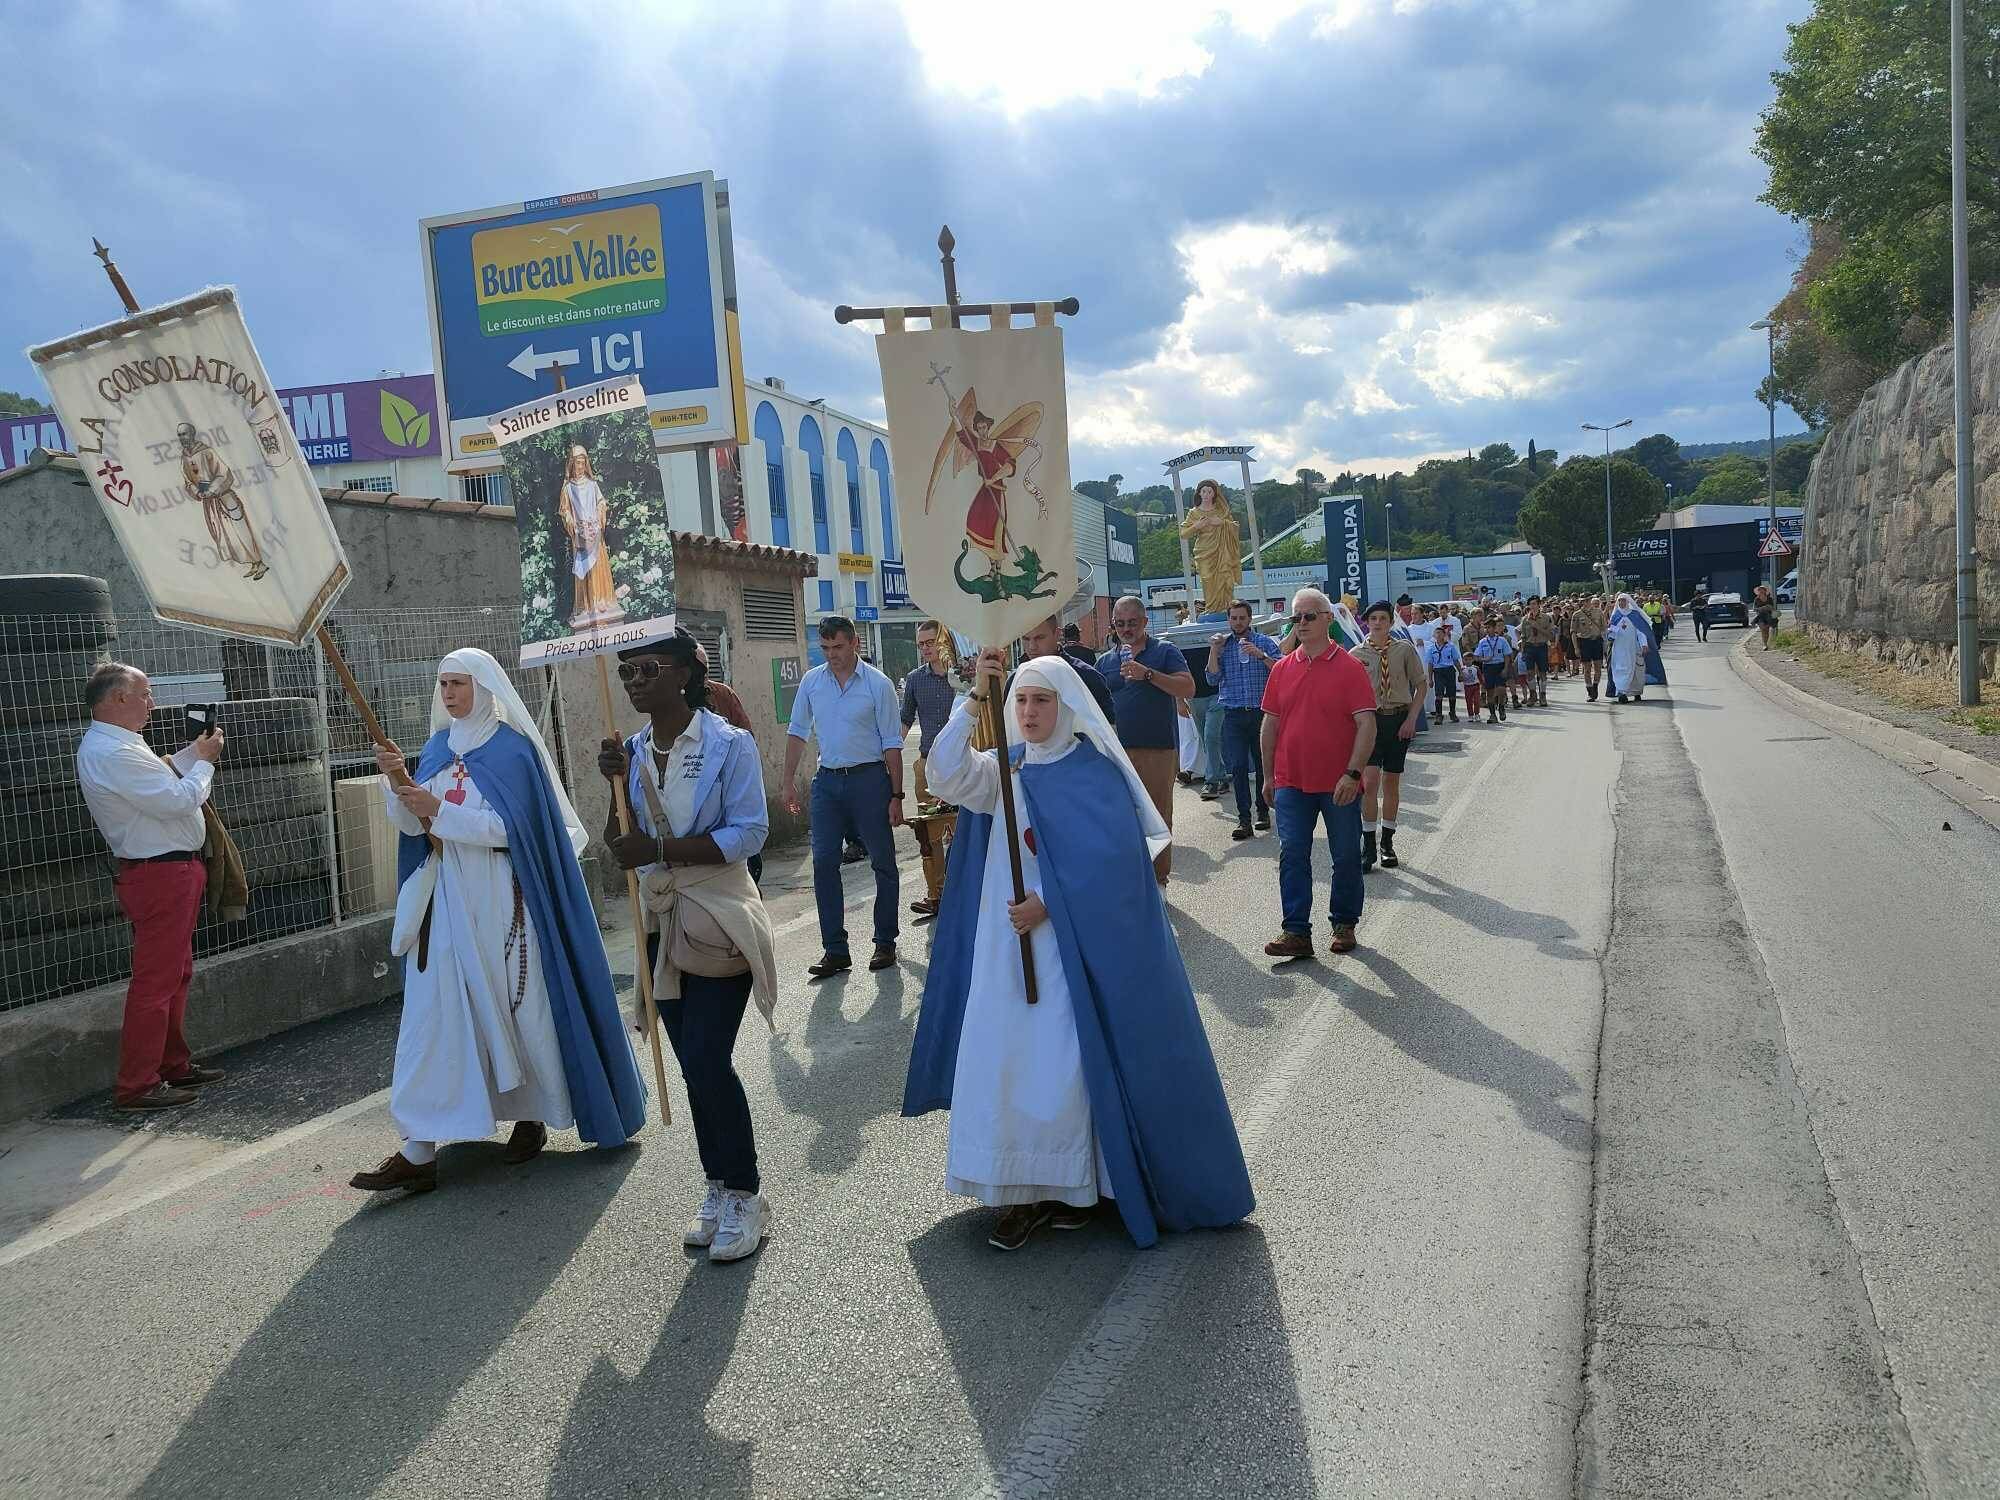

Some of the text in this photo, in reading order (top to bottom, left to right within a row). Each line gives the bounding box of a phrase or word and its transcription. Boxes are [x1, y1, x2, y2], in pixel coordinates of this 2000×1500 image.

[526, 191, 598, 210] ESPACES CONSEILS
[481, 235, 657, 298] Bureau Vallée
[487, 298, 660, 332] Le discount est dans notre nature
[591, 330, 644, 374] ICI
[78, 417, 105, 455] LA
[99, 355, 268, 410] CONSOLATION
[500, 386, 629, 436] Sainte Roseline
[659, 412, 698, 424] HIGH-TECH
[11, 421, 67, 466] HA
[302, 442, 350, 461] NERIE
[1168, 446, 1244, 468] ORA PRO POPULO
[1344, 504, 1361, 599] MOBALPA
[884, 573, 909, 595] LA HAL
[544, 628, 648, 658] Priez pour nous.
[780, 660, 799, 681] 451
